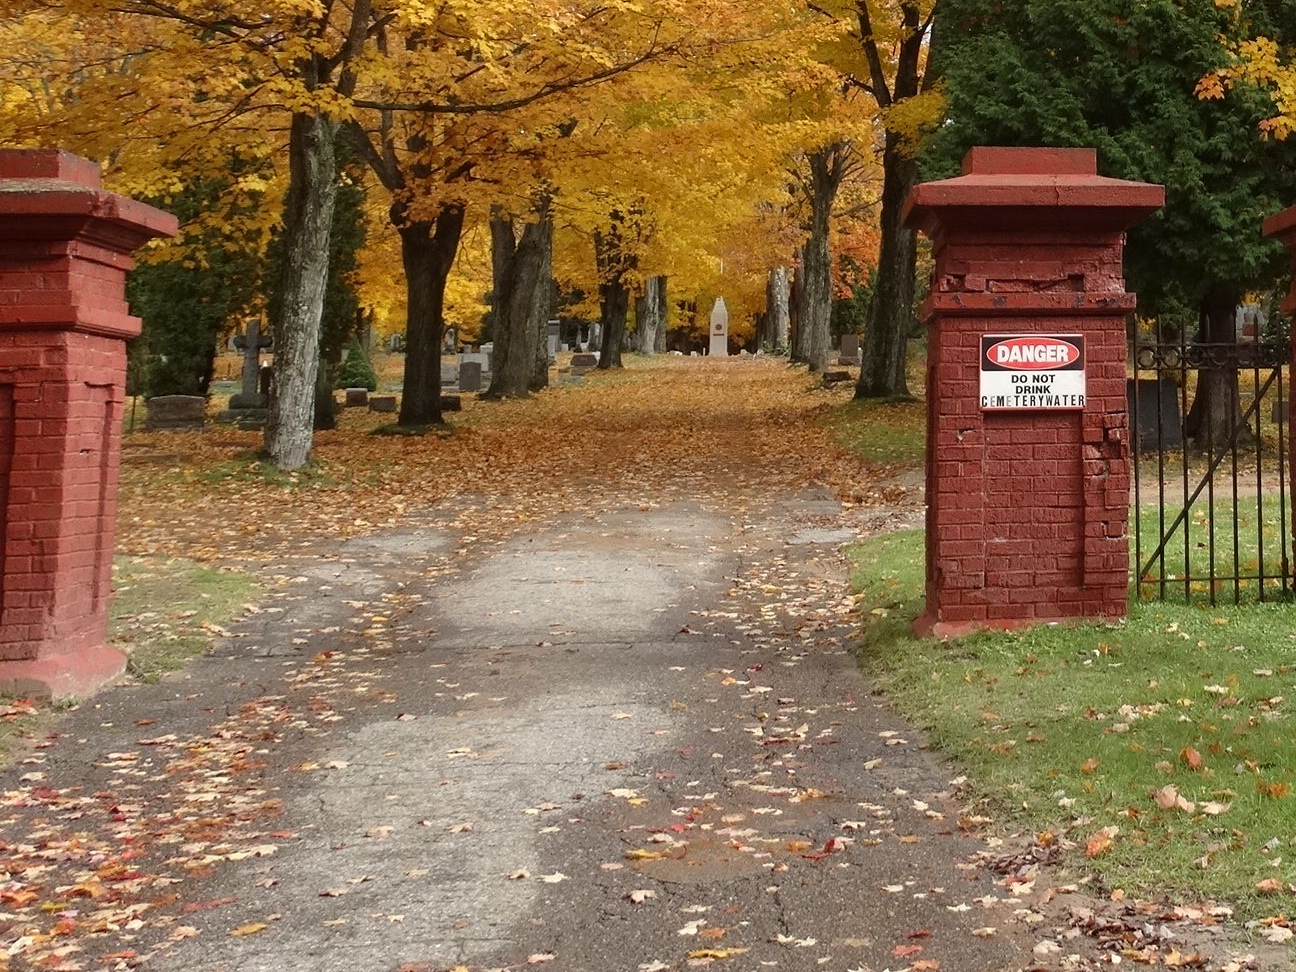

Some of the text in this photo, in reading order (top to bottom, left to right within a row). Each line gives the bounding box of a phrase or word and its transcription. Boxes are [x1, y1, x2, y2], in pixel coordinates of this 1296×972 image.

[997, 345, 1069, 363] DANGER
[1011, 374, 1056, 384] DO NOT
[1015, 385, 1051, 394] DRINK
